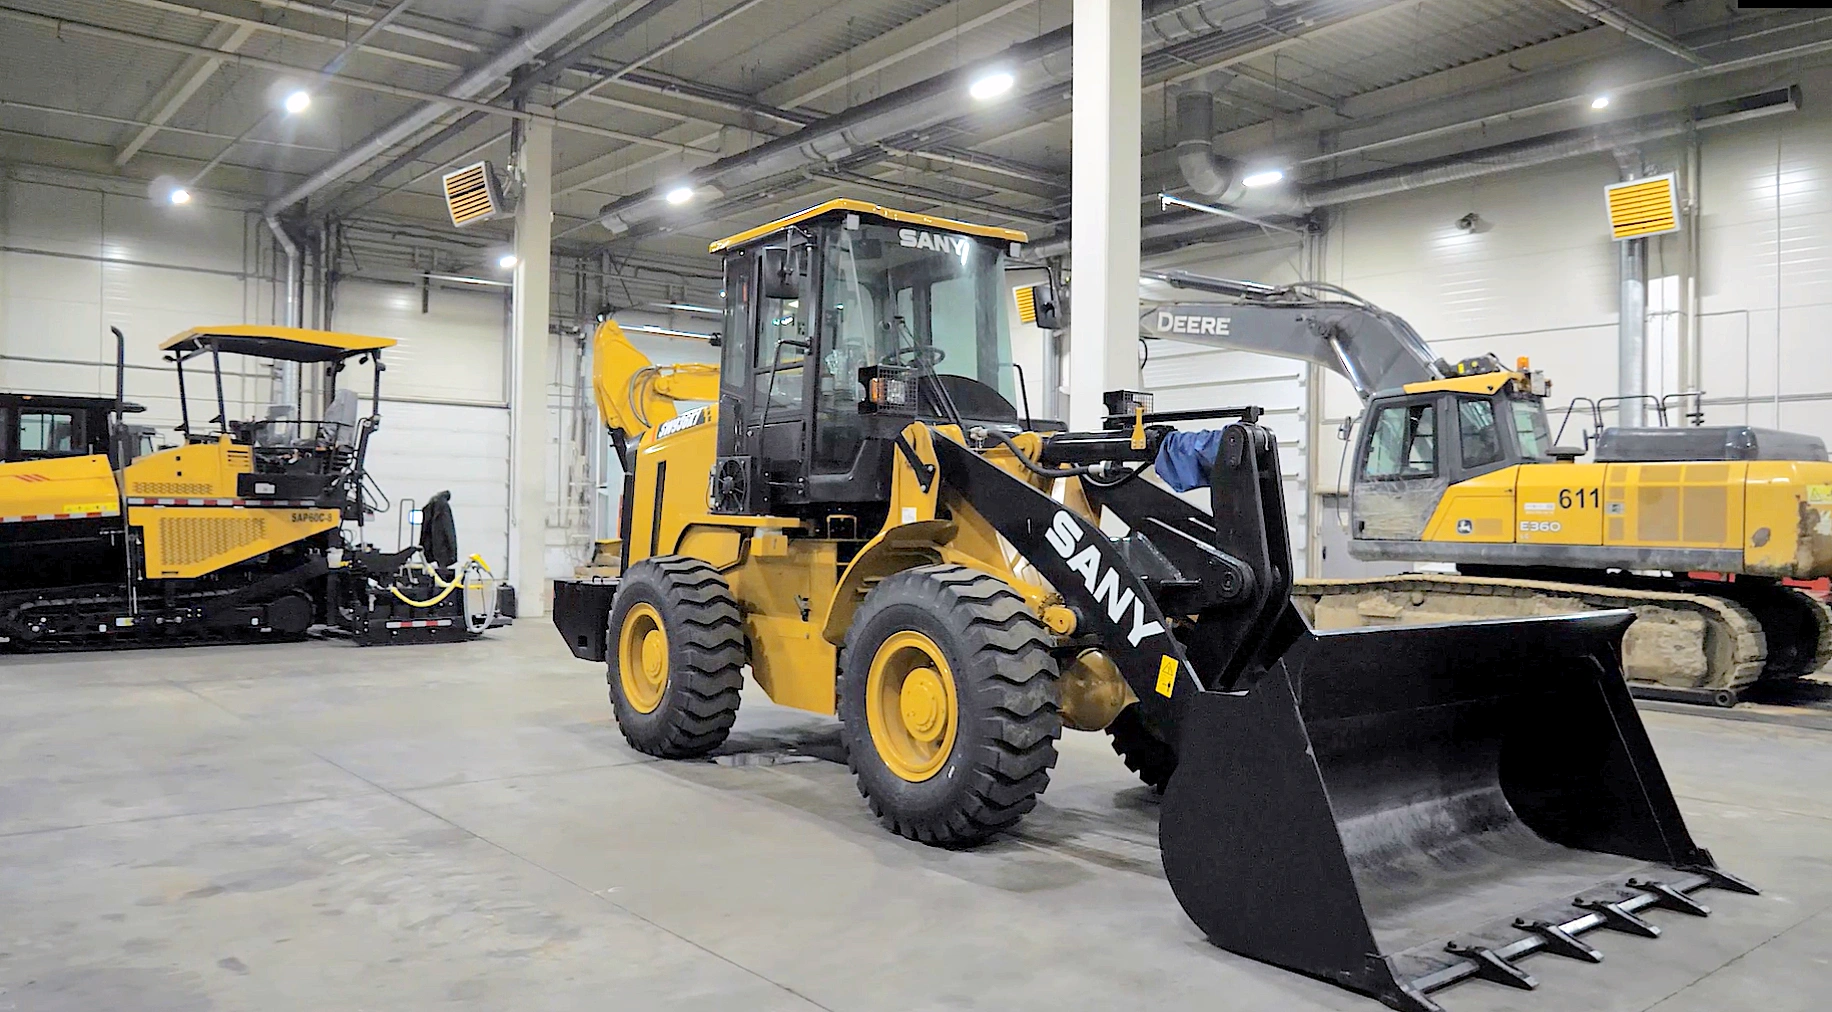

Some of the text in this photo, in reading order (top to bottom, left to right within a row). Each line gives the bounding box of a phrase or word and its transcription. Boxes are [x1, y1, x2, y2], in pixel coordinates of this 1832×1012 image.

[899, 228, 966, 256] SANY
[1157, 311, 1231, 336] DEERE
[1559, 488, 1599, 509] 611
[1519, 521, 1561, 532] E360
[1045, 510, 1165, 648] SANY
